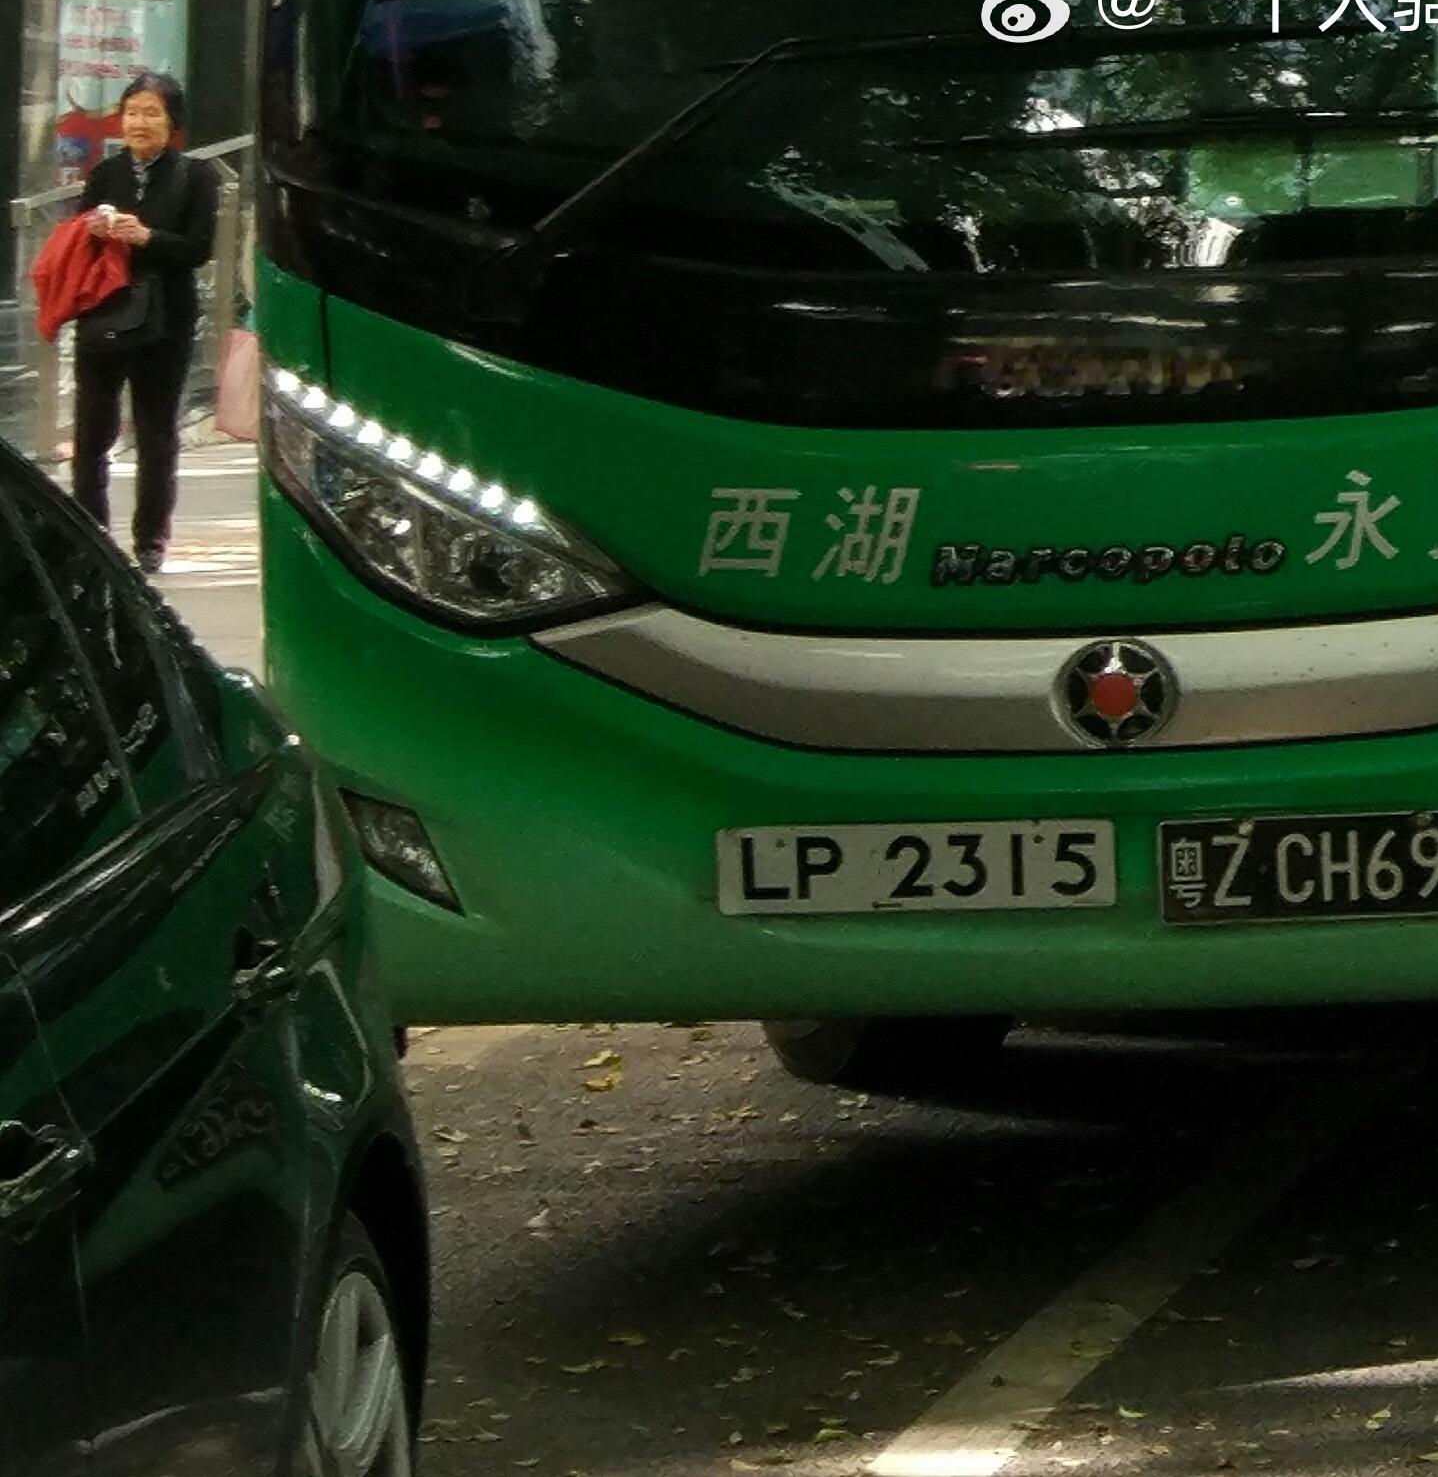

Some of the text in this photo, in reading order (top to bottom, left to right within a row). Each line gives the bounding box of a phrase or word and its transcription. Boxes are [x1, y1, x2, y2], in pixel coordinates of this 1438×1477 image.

[698, 485, 922, 584] 西湖
[741, 833, 1098, 901] LP 2315
